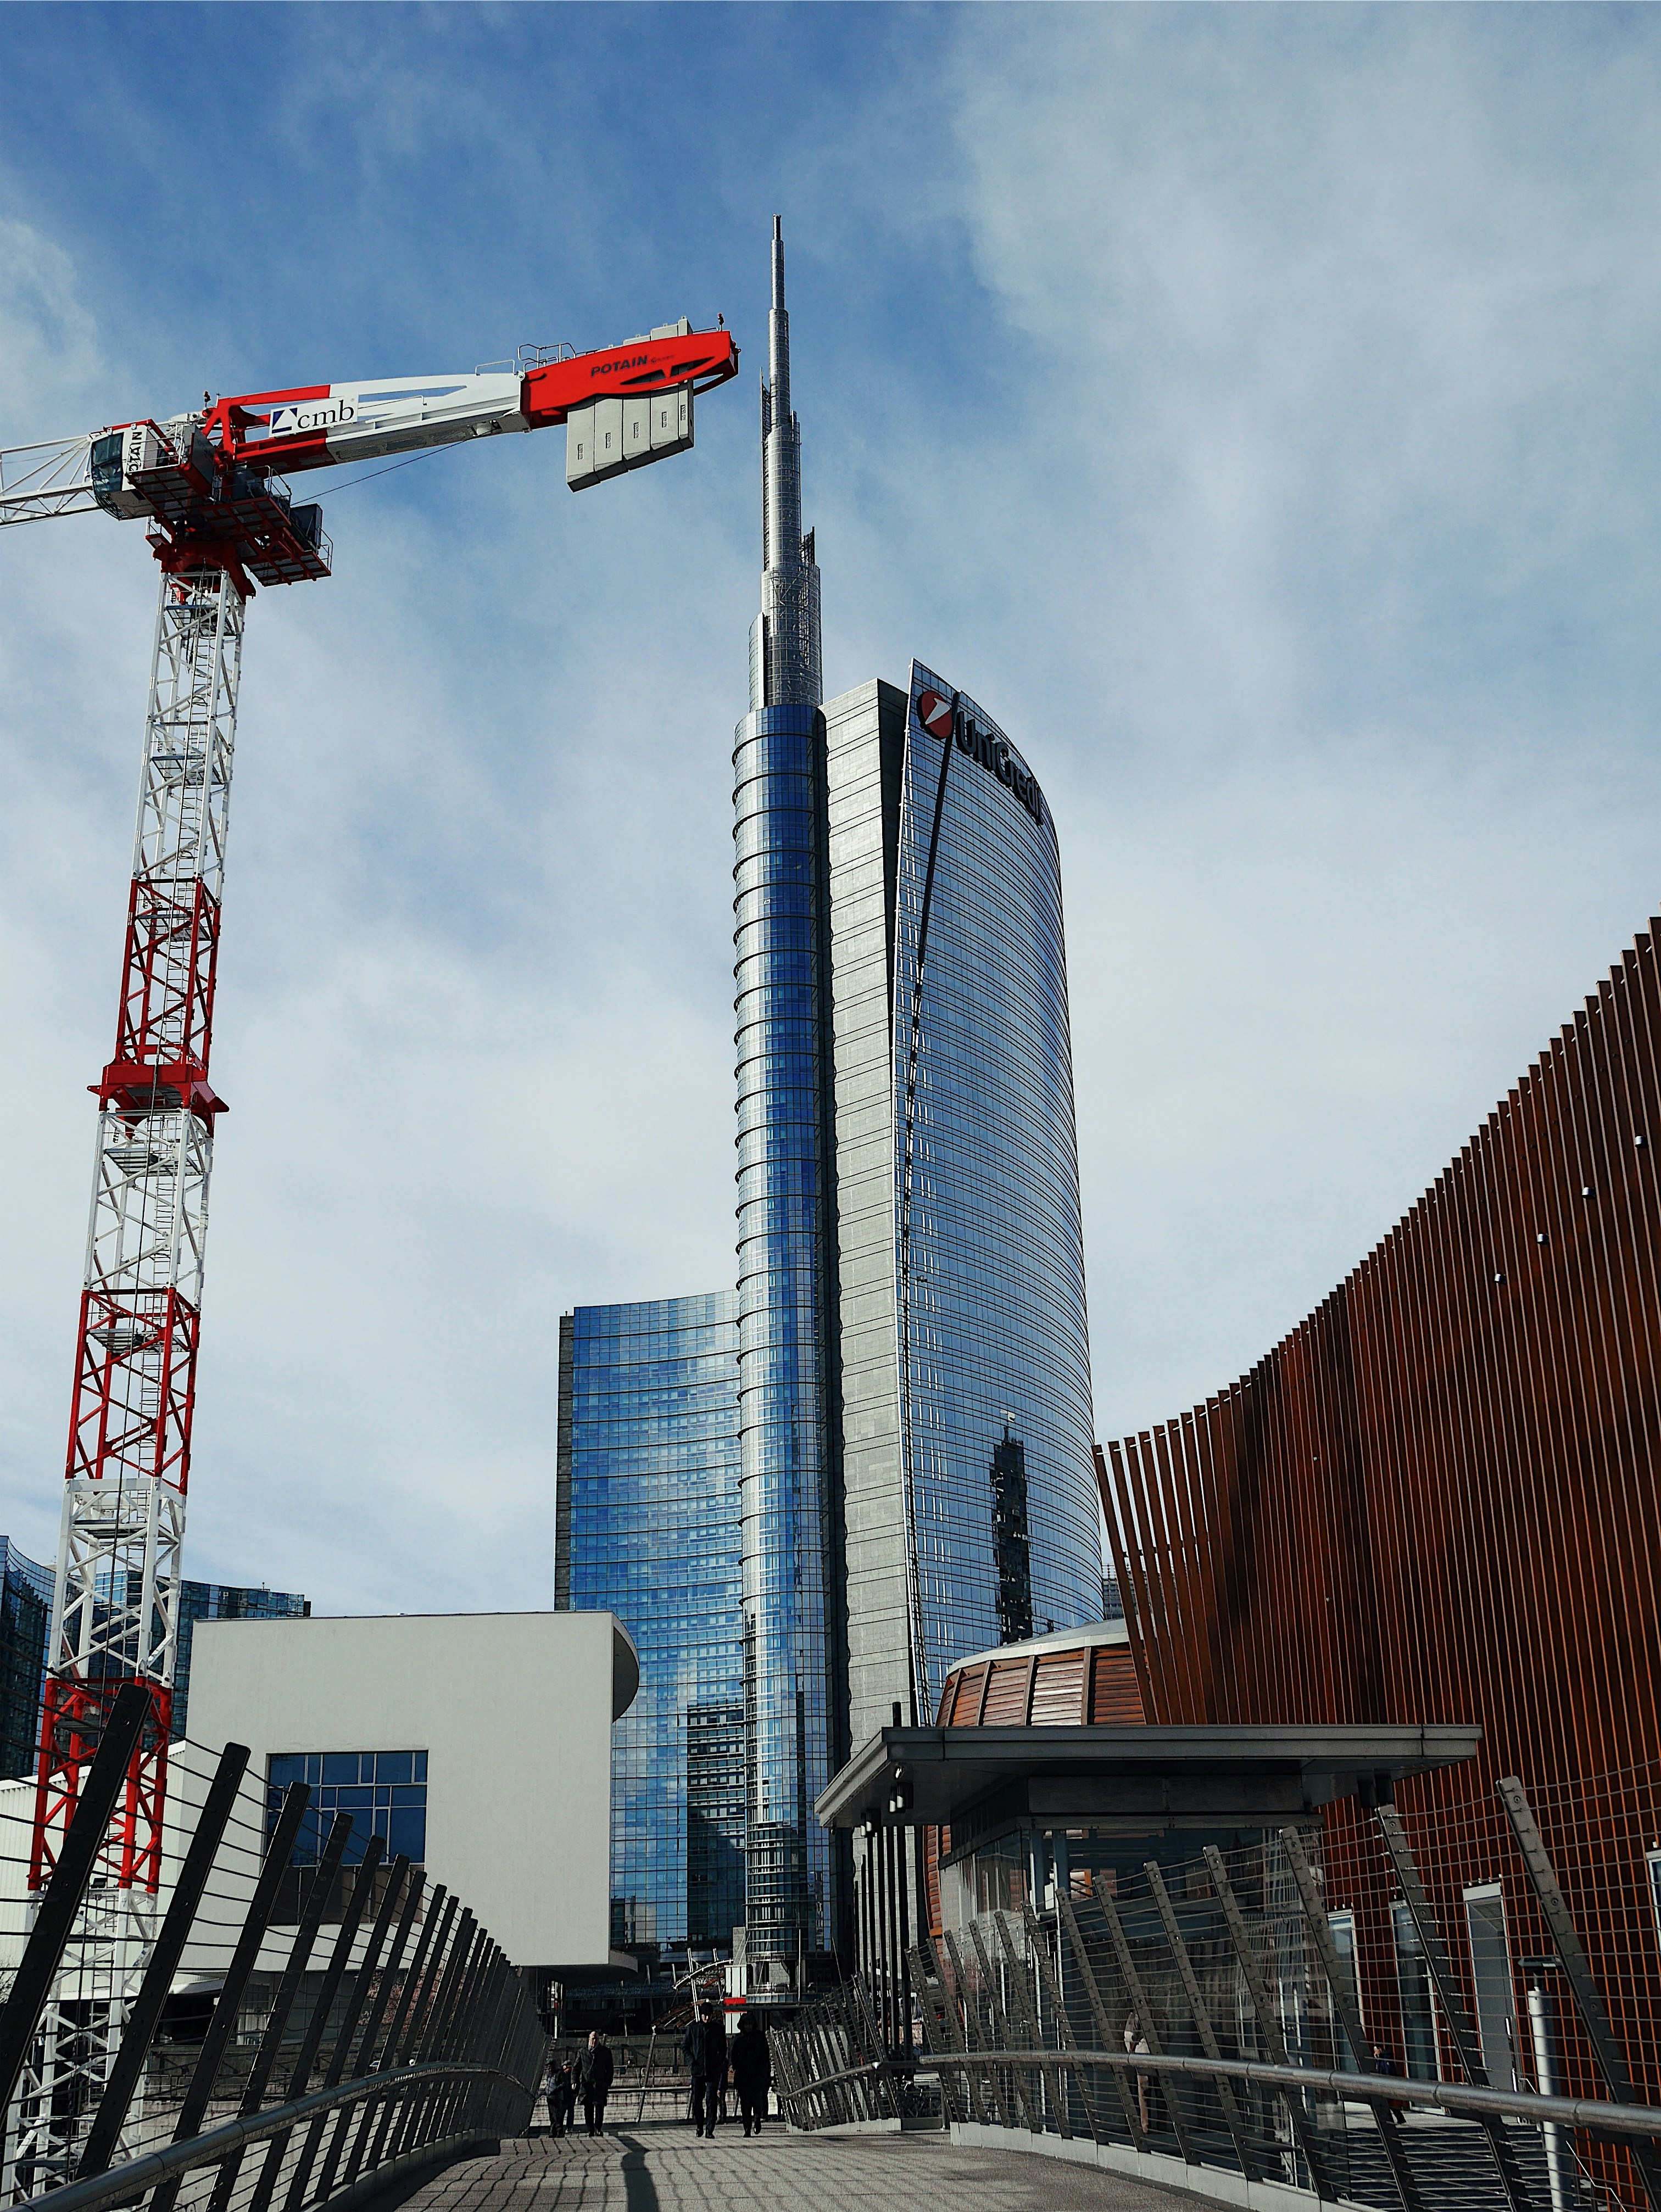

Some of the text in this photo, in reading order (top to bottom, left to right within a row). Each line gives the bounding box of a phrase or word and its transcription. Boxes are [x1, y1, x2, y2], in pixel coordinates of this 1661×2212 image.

[590, 355, 648, 377] POTAIN
[297, 399, 354, 429] cmb
[129, 432, 142, 472] OTAIN
